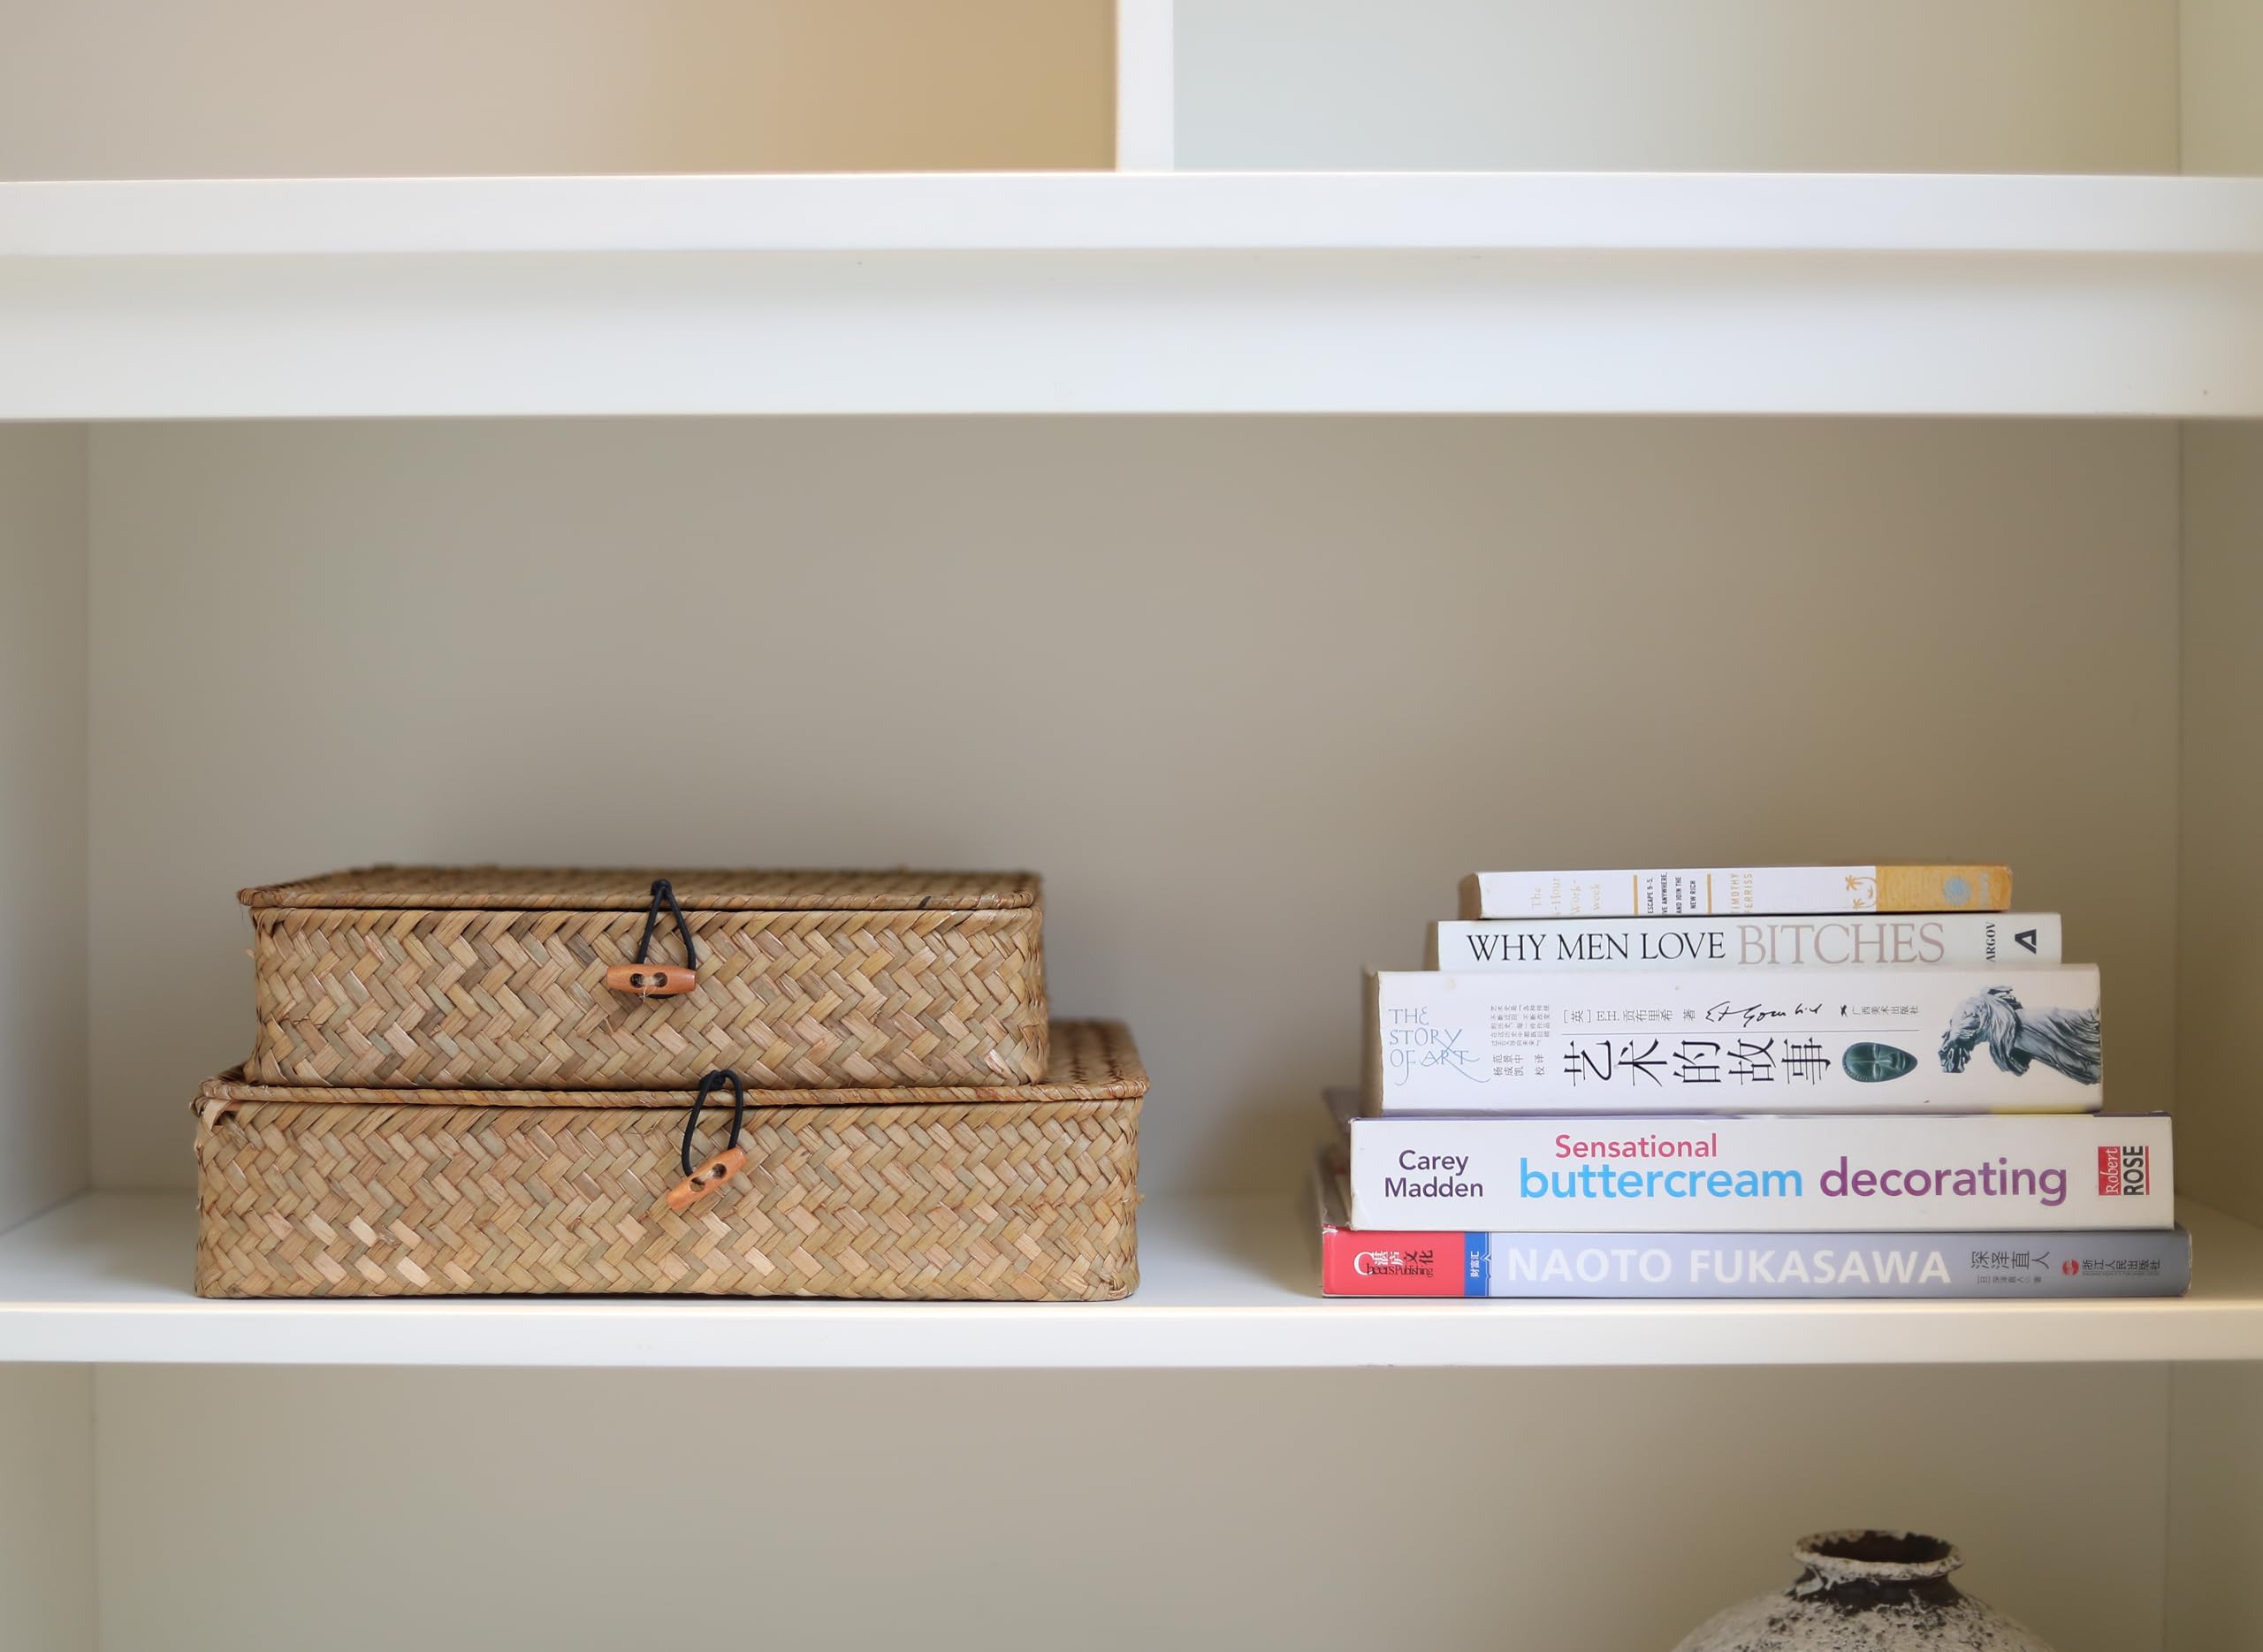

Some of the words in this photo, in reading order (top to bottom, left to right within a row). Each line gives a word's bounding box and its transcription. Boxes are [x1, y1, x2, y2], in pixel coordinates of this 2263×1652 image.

[1467, 933, 1546, 962] WHY
[1557, 933, 1629, 961] MEN
[1641, 932, 1726, 960] LOVE
[1738, 922, 1946, 966] BITCHES
[1985, 921, 1996, 963] ARGOV
[1388, 1006, 1429, 1025] THE
[1683, 1009, 1696, 1022] 著
[1852, 1005, 1919, 1016] 广西美术出版社
[1389, 1027, 1466, 1064] STORY
[1534, 1054, 1544, 1063] 译
[1390, 1048, 1416, 1082] OF
[1534, 1066, 1545, 1076] 校
[1563, 1037, 1832, 1087] 艺术的故事
[1555, 1132, 1718, 1160] Sensational
[1398, 1149, 1469, 1177] Carey
[2105, 1147, 2119, 1195] Robert
[2122, 1146, 2145, 1196] ROSE
[1384, 1176, 1483, 1199] Madden
[1520, 1156, 1803, 1199] buttercream
[1819, 1155, 2068, 1207] decorating
[1508, 1248, 1672, 1283] NAOTO
[1689, 1249, 1952, 1284] FUKASAWA
[1970, 1251, 2051, 1270] 深泽直人
[2081, 1259, 2160, 1271] 浙江人民出版社
